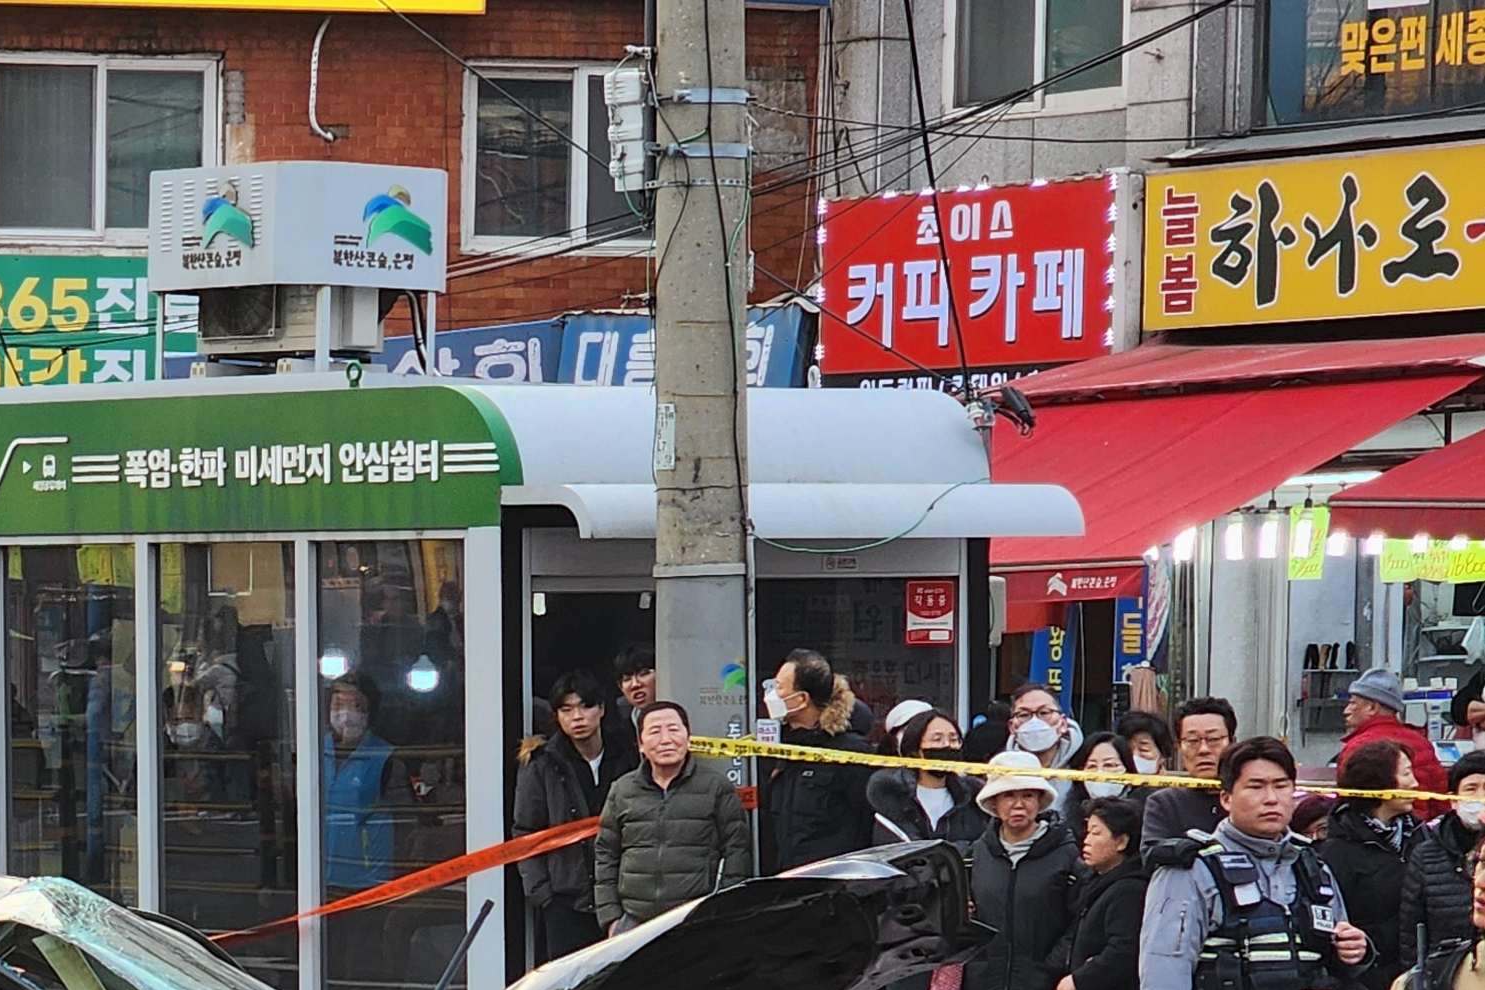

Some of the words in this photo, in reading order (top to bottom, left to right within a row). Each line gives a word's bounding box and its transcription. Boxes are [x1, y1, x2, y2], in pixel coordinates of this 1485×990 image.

[1340, 16, 1428, 76] 맞은편
[916, 199, 1014, 246] 초이스
[1159, 186, 1200, 316] 늘봄
[846, 259, 950, 349] 커피
[968, 248, 1085, 343] 카페
[123, 446, 227, 490] 폭염·한파
[234, 443, 332, 487] 미세먼지
[338, 439, 439, 484] 안심쉼터
